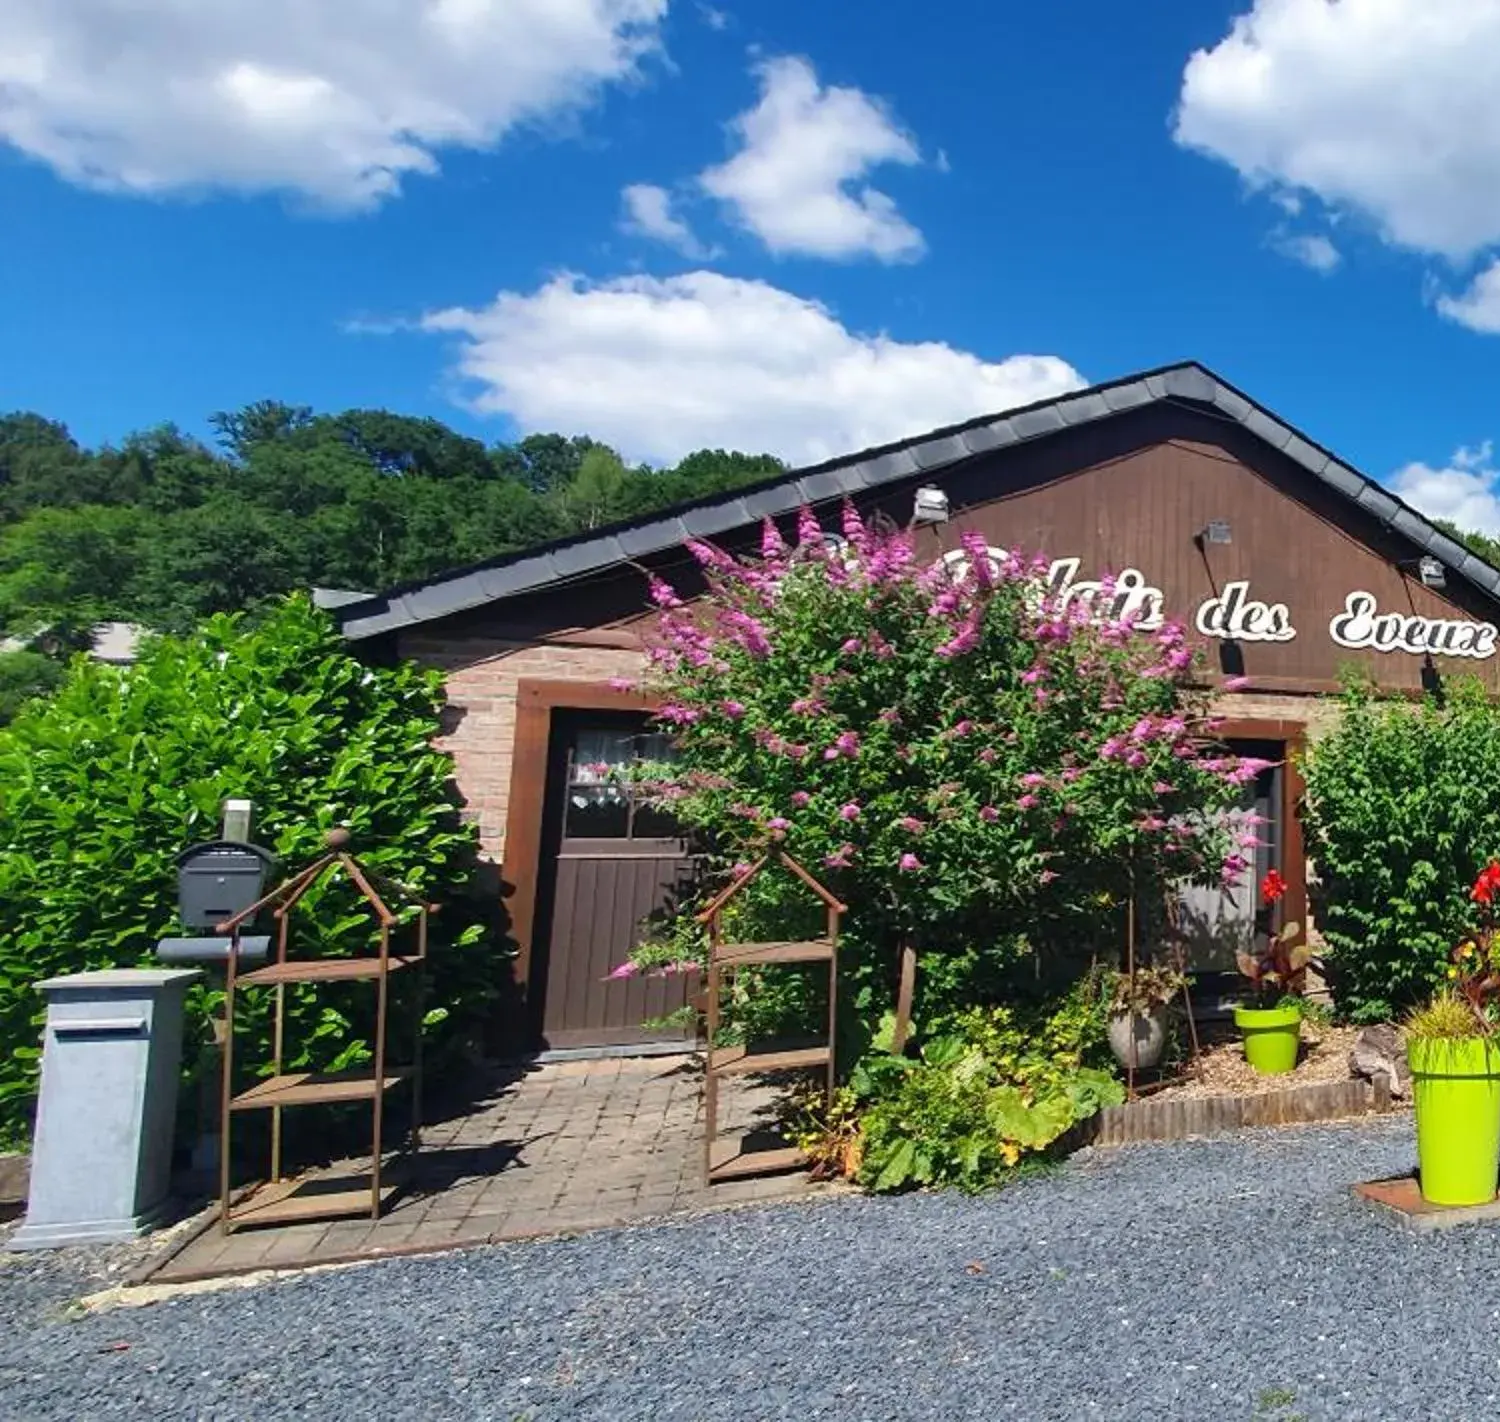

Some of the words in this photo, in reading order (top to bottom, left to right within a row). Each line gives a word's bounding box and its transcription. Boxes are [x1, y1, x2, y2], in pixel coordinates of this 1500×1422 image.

[943, 546, 1164, 631] lais
[1197, 582, 1296, 640] des
[1330, 591, 1497, 658] Eveux
